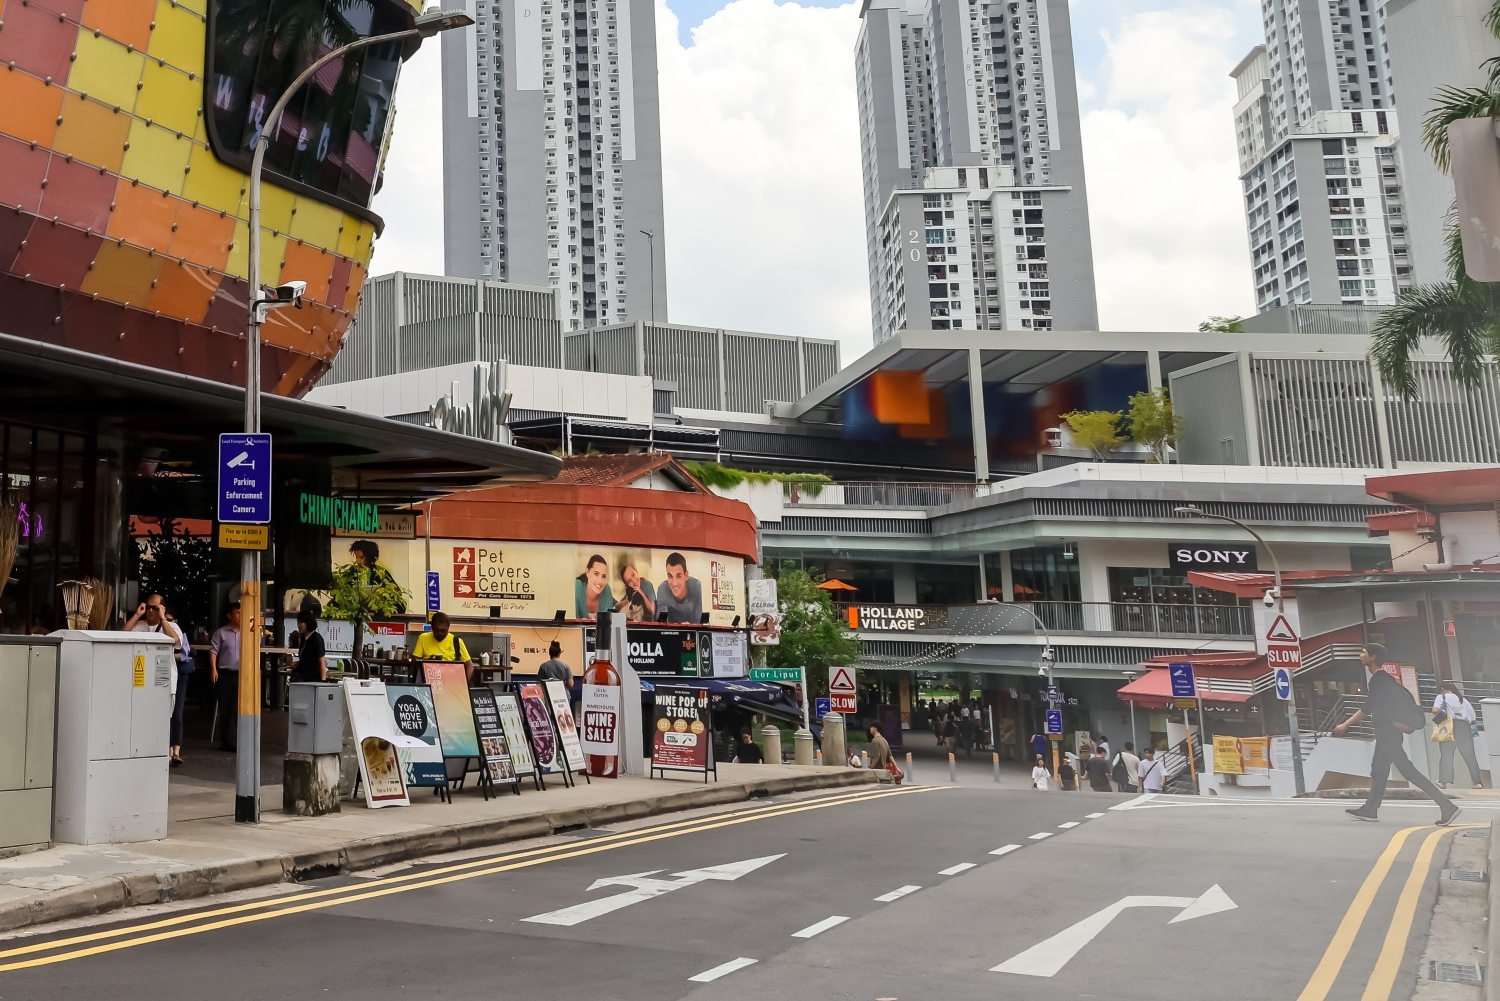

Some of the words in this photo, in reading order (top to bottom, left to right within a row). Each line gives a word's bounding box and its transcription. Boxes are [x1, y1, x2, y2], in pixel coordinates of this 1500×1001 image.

[233, 477, 256, 488] Parking
[225, 491, 263, 500] Enforcement
[232, 504, 256, 513] Camera
[300, 493, 379, 533] CHIMICHANGA
[479, 549, 503, 563] Pet
[1176, 549, 1249, 563] SONY
[479, 563, 530, 578] Lovers
[479, 578, 530, 593] Centre
[861, 607, 924, 619] HOLLAND
[377, 626, 388, 634] NO
[861, 618, 916, 630] VILLAGE
[1268, 650, 1299, 663] SLOW
[773, 670, 799, 679] Liput
[398, 703, 421, 712] YOGA
[655, 695, 676, 706] WINE
[678, 696, 695, 707] POP
[698, 698, 709, 708] UP
[831, 697, 855, 709] SLOW
[399, 712, 422, 721] MOVE
[587, 712, 613, 728] WINE
[401, 721, 423, 730] MENT
[586, 727, 612, 742] SALE
